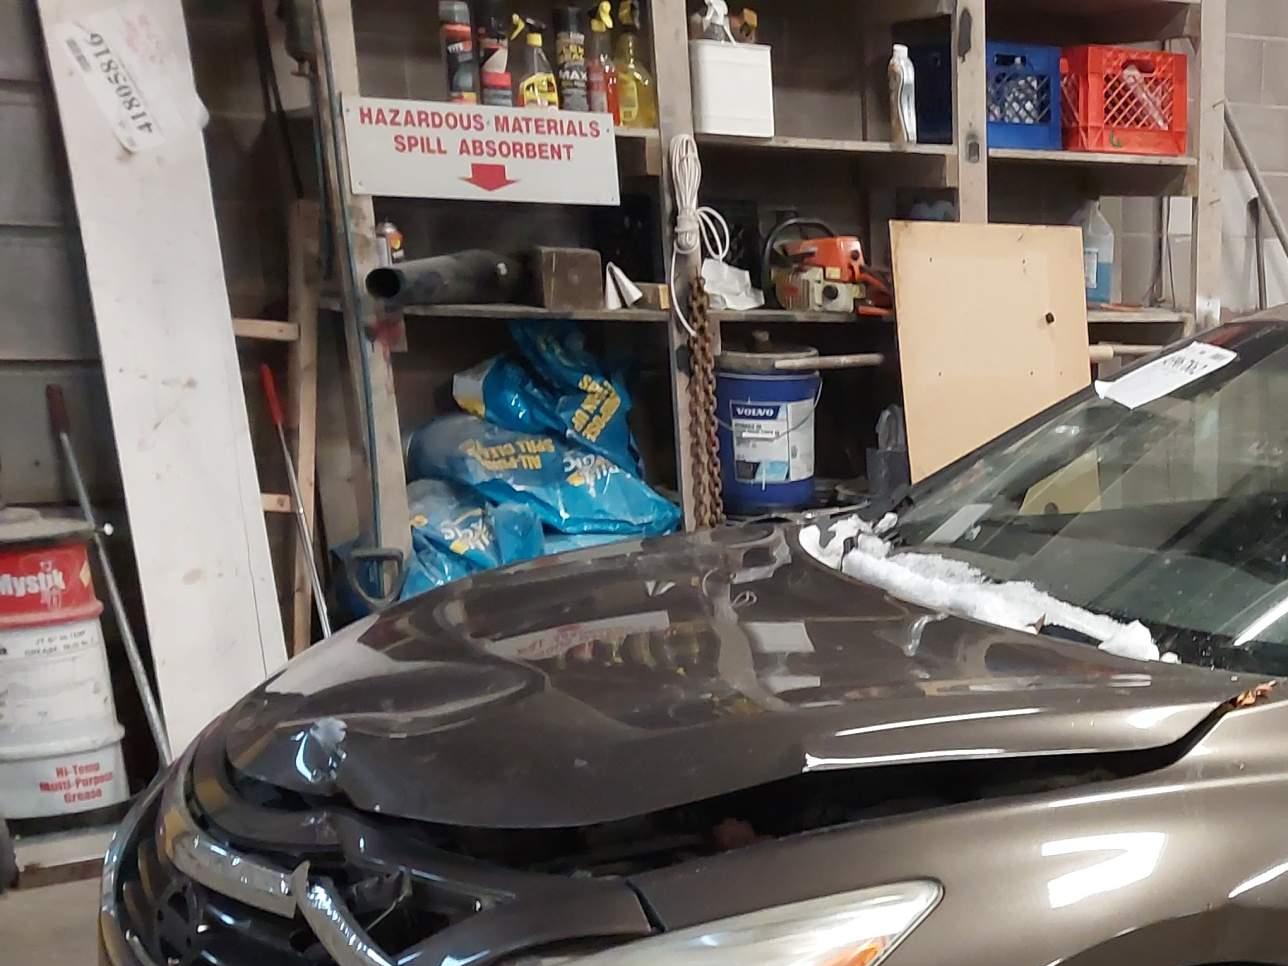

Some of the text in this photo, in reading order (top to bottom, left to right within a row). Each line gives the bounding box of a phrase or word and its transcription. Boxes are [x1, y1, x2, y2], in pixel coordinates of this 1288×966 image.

[87, 32, 154, 134] 41805816
[559, 69, 587, 80] MAX
[359, 106, 601, 138] HAZARDOUS MATERIALS
[393, 134, 574, 161] SPILL ABSORBENT
[735, 406, 775, 418] VOLVO
